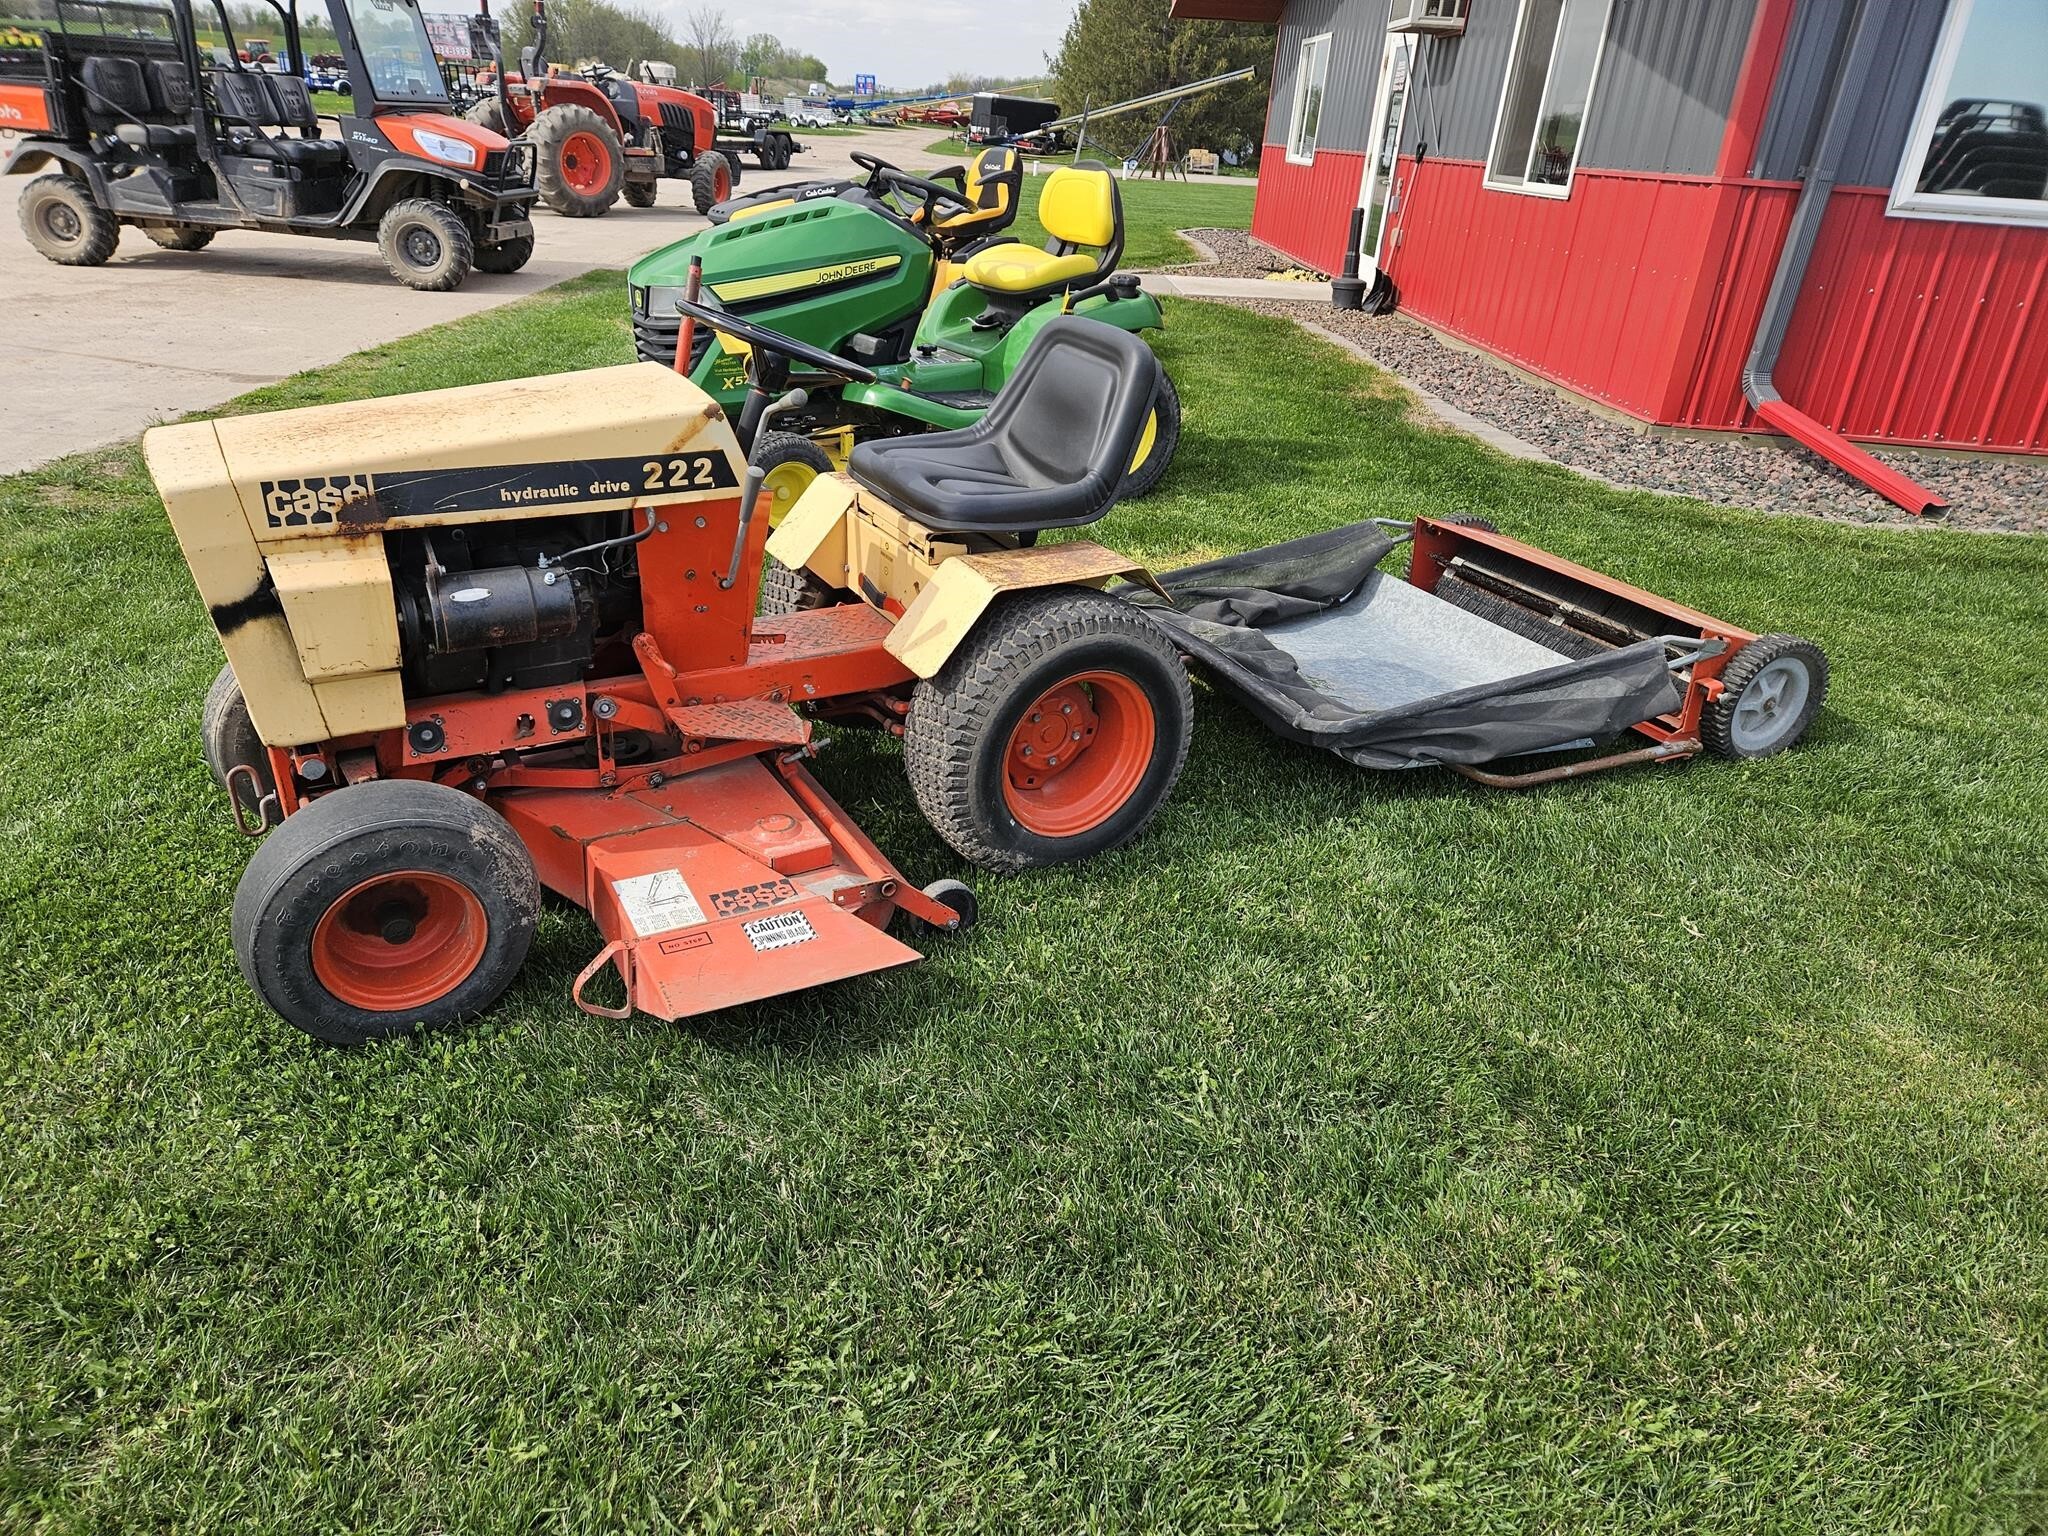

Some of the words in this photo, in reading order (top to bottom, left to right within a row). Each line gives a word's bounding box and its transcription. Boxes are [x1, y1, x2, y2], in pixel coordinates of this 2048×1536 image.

[816, 270, 843, 282] JOHN
[845, 261, 876, 276] DEERE
[501, 484, 579, 502] hydraulic
[589, 480, 631, 494] drive
[642, 457, 714, 490] 222
[262, 478, 370, 522] case
[711, 880, 796, 914] case
[751, 914, 802, 934] CAUTION
[683, 937, 703, 946] STEP
[755, 929, 788, 946] SPINNING
[787, 925, 809, 939] BLADE
